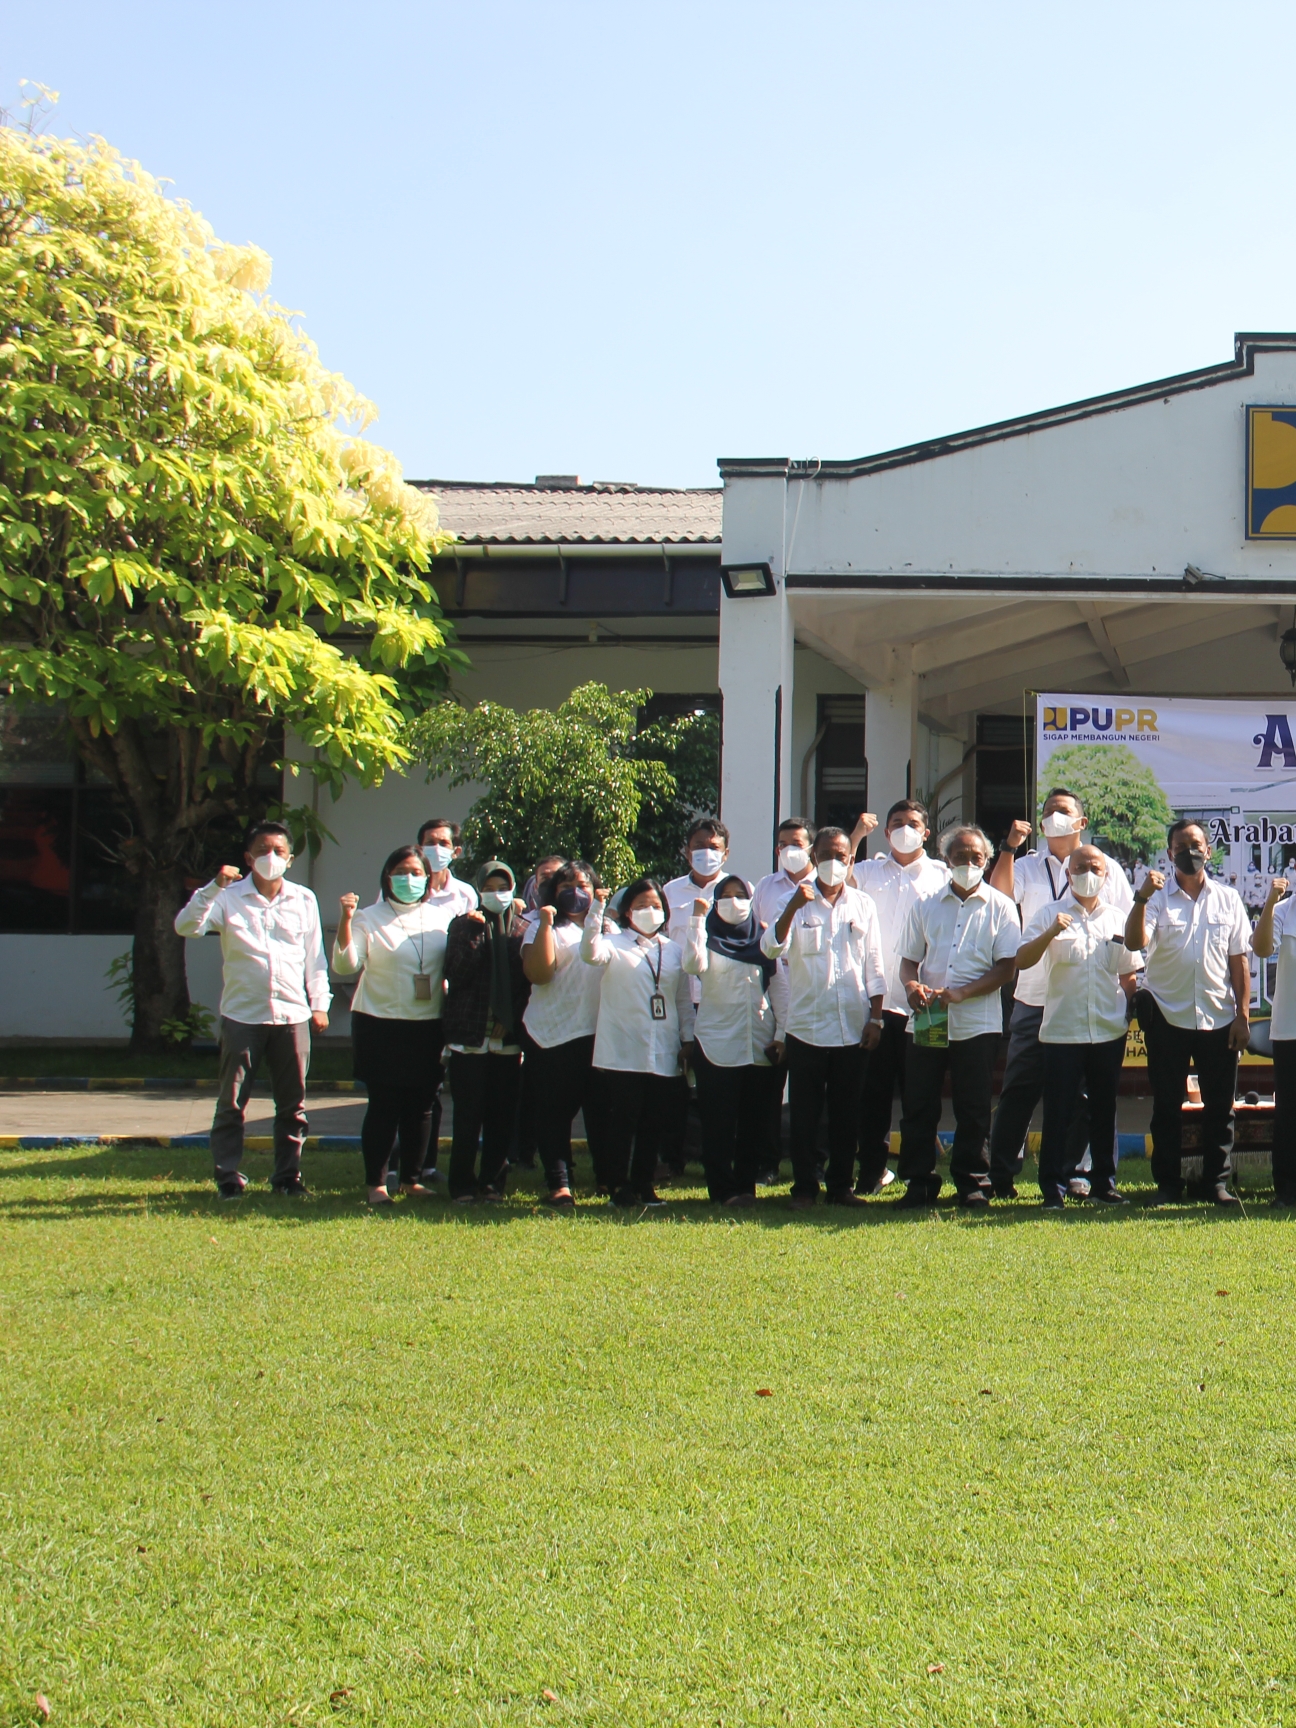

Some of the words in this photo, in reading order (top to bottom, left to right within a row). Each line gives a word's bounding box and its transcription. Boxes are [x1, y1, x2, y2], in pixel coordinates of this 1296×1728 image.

[1069, 707, 1159, 732] PUPR
[1043, 733, 1069, 741] SIGAP
[1071, 733, 1127, 741] MEMBANGUN
[1129, 734, 1160, 742] NEGERI
